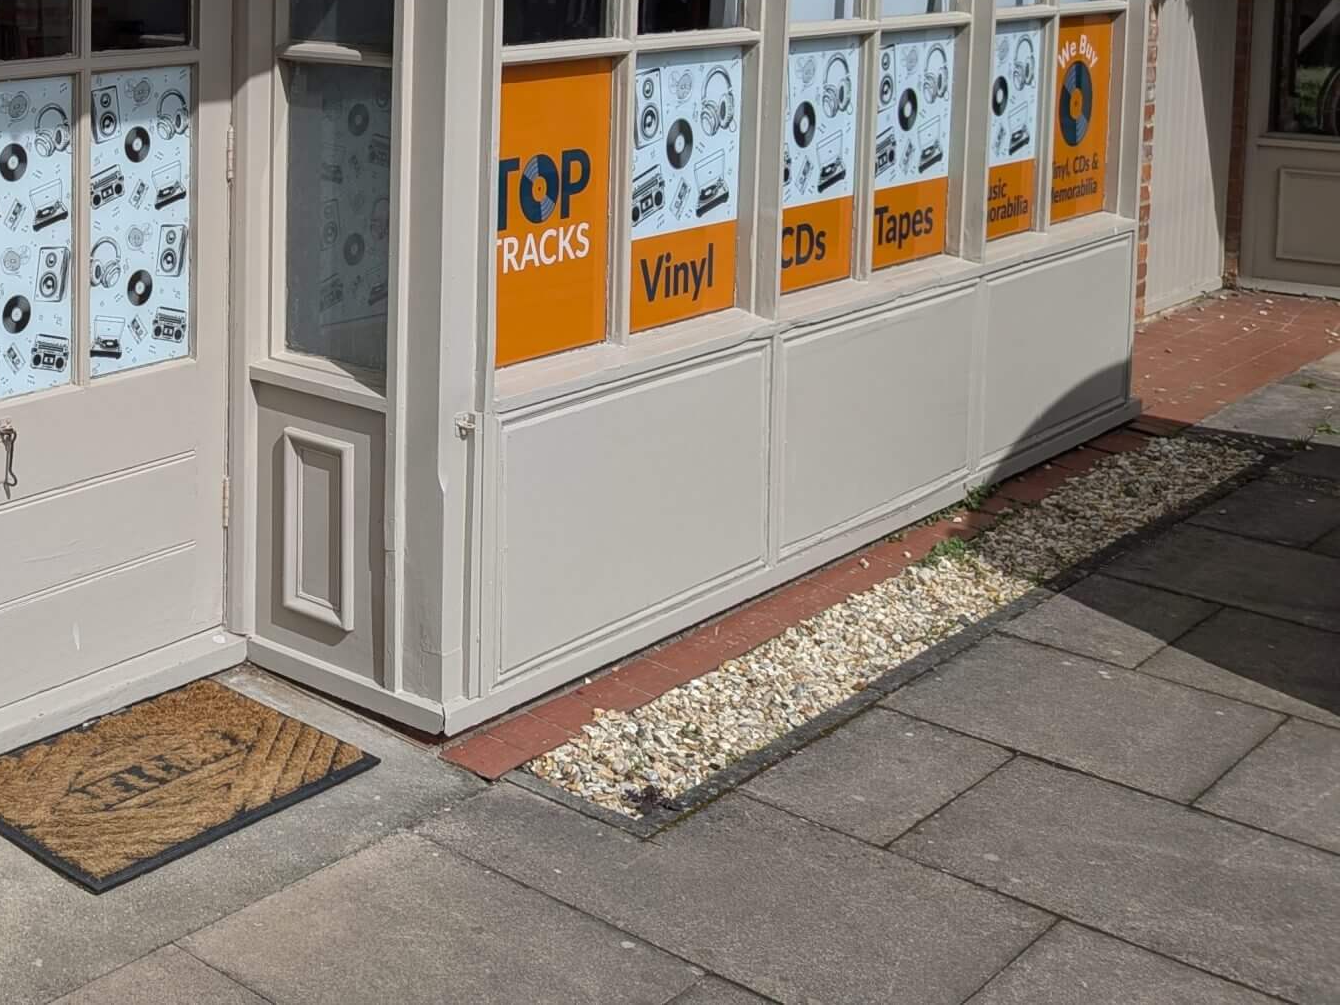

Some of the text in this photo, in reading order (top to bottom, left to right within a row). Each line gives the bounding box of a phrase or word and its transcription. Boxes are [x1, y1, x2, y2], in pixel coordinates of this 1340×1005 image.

[1058, 34, 1099, 69] We Buy
[1052, 152, 1099, 181] inyl, CDs &
[1051, 178, 1097, 204] emorabilia
[496, 222, 591, 274] RACKS
[781, 223, 827, 269] CDs
[874, 205, 933, 250] Tapes
[640, 243, 714, 303] Vinyl
